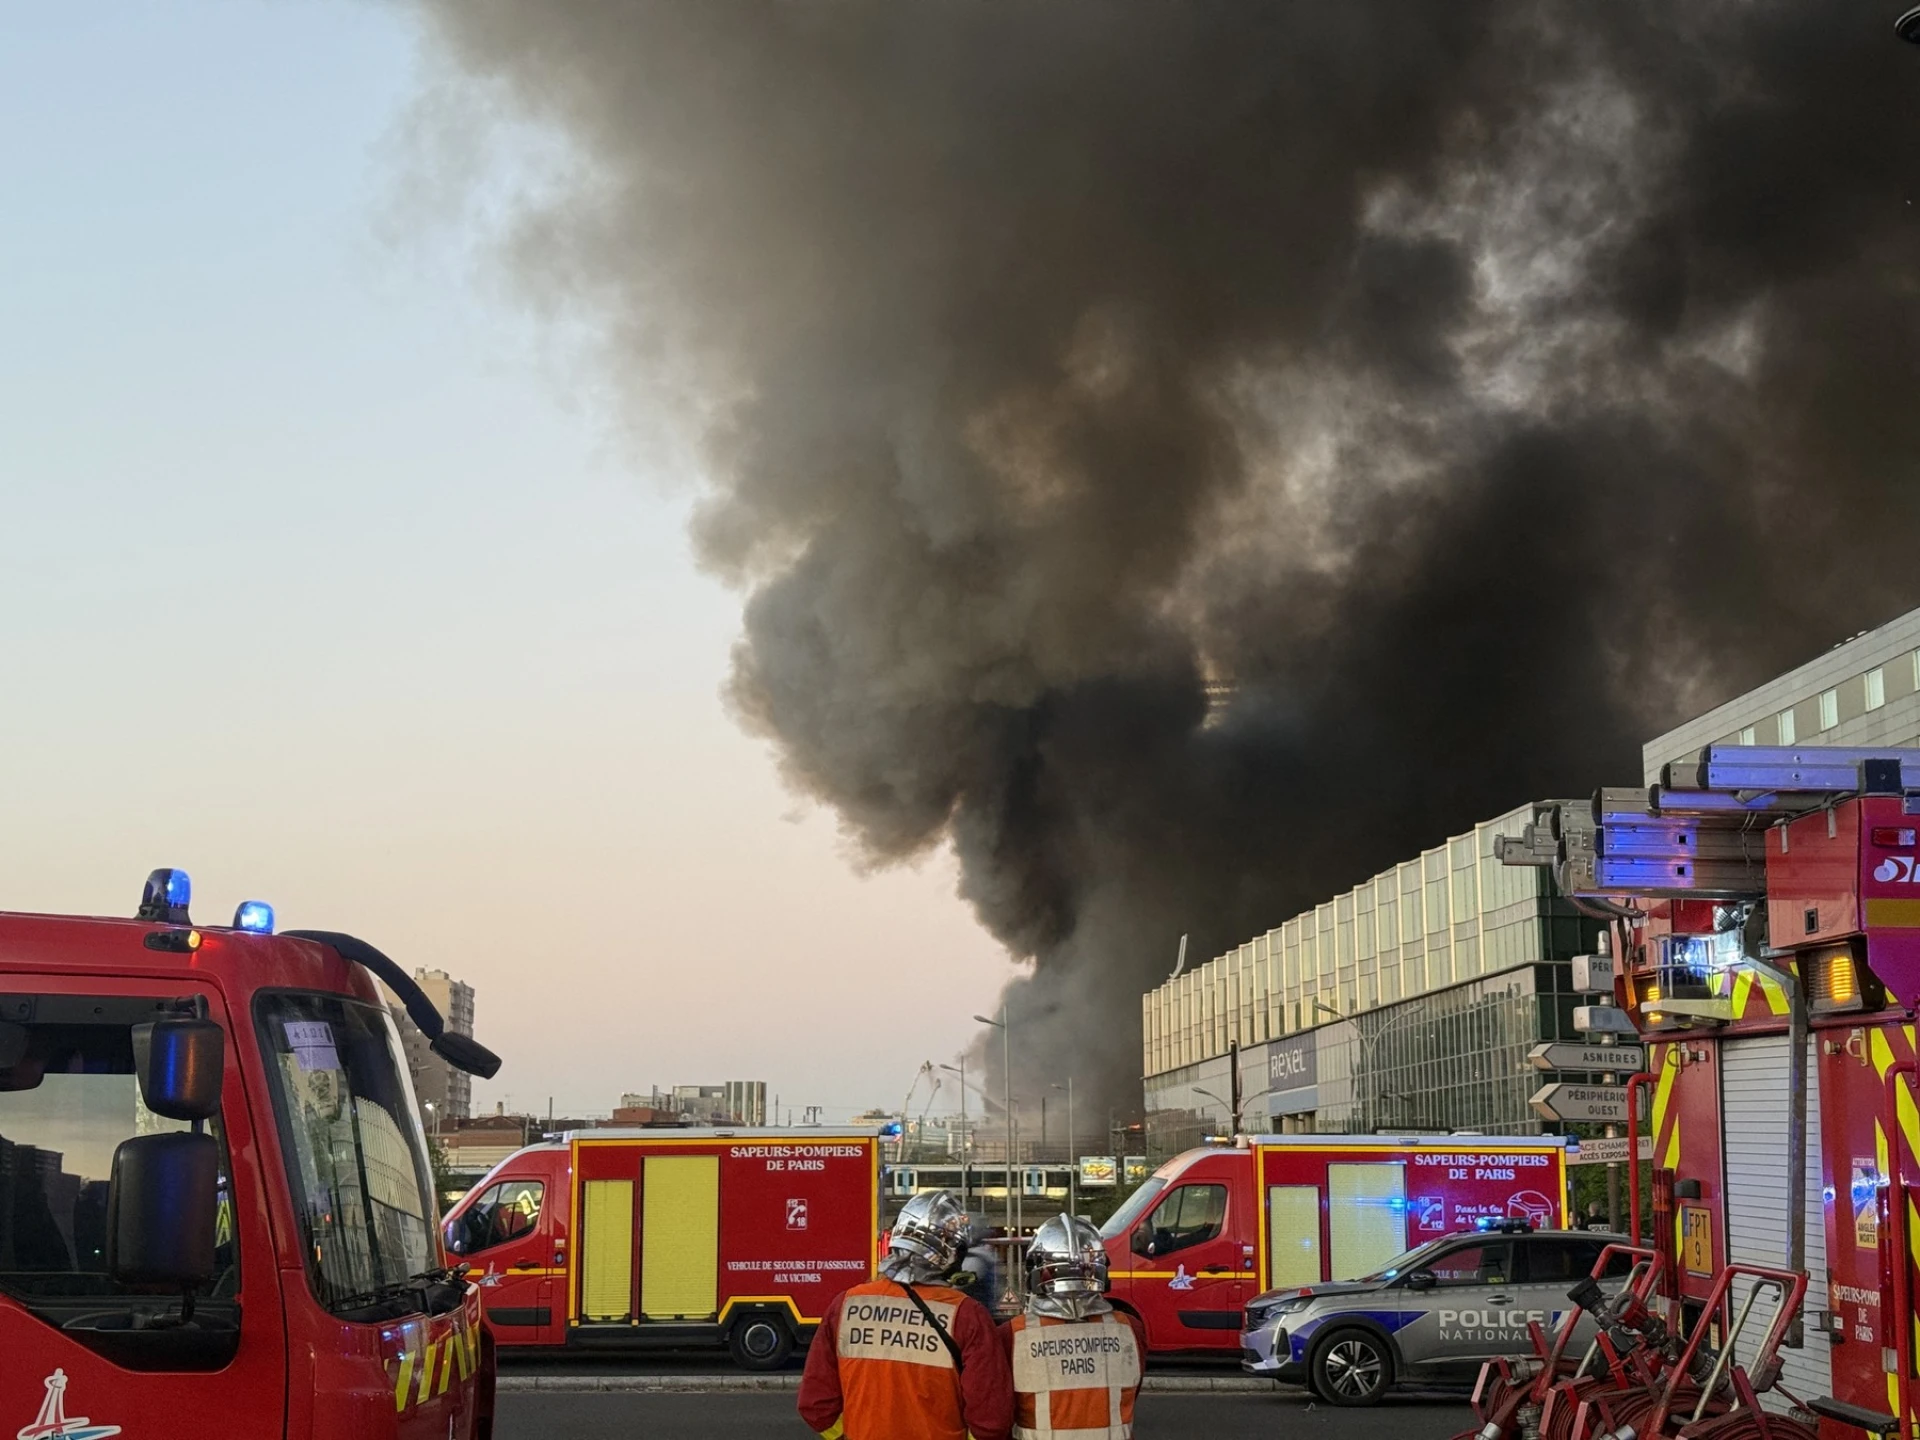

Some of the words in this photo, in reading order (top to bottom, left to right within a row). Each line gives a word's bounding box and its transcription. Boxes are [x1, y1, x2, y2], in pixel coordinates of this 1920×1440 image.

[1583, 1052, 1637, 1064] ASNIÈRES
[1568, 1087, 1630, 1103] PÉRIPHÉRIQ
[1588, 1105, 1619, 1115] OUEST
[1598, 1139, 1649, 1151] CHAMPRET
[730, 1146, 863, 1158] SAPEURS-POMPIERS
[1601, 1150, 1630, 1160] EXPOSAN
[766, 1160, 785, 1171] DE
[788, 1160, 825, 1171] PARIS
[1415, 1154, 1549, 1167] SAPEURS-POMPIERS
[1448, 1168, 1468, 1180] DE
[1475, 1168, 1516, 1180] PARIS
[787, 1199, 799, 1208] 112
[1454, 1204, 1478, 1214] Dans
[1478, 1204, 1488, 1214] le
[797, 1217, 806, 1227] 18
[1430, 1219, 1443, 1229] 112
[1455, 1215, 1468, 1223] de
[1689, 1213, 1707, 1239] FPT
[1694, 1240, 1701, 1267] 9
[762, 1261, 772, 1270] DE
[773, 1261, 806, 1270] SECOURS
[806, 1261, 816, 1270] ET
[817, 1260, 865, 1270] D'ASSISTANCE
[773, 1273, 789, 1283] AUX
[789, 1273, 822, 1283] VICTIMES
[1439, 1309, 1545, 1328] POLICE
[1858, 1307, 1868, 1324] DE
[850, 1327, 875, 1345] DE
[880, 1329, 939, 1352] PARIS
[1440, 1330, 1544, 1340] NATIONAL
[1855, 1324, 1873, 1343] PARIS
[1031, 1338, 1074, 1358] SAPEURS
[1075, 1337, 1120, 1354] POMPIERS
[1061, 1357, 1095, 1375] PARIS
